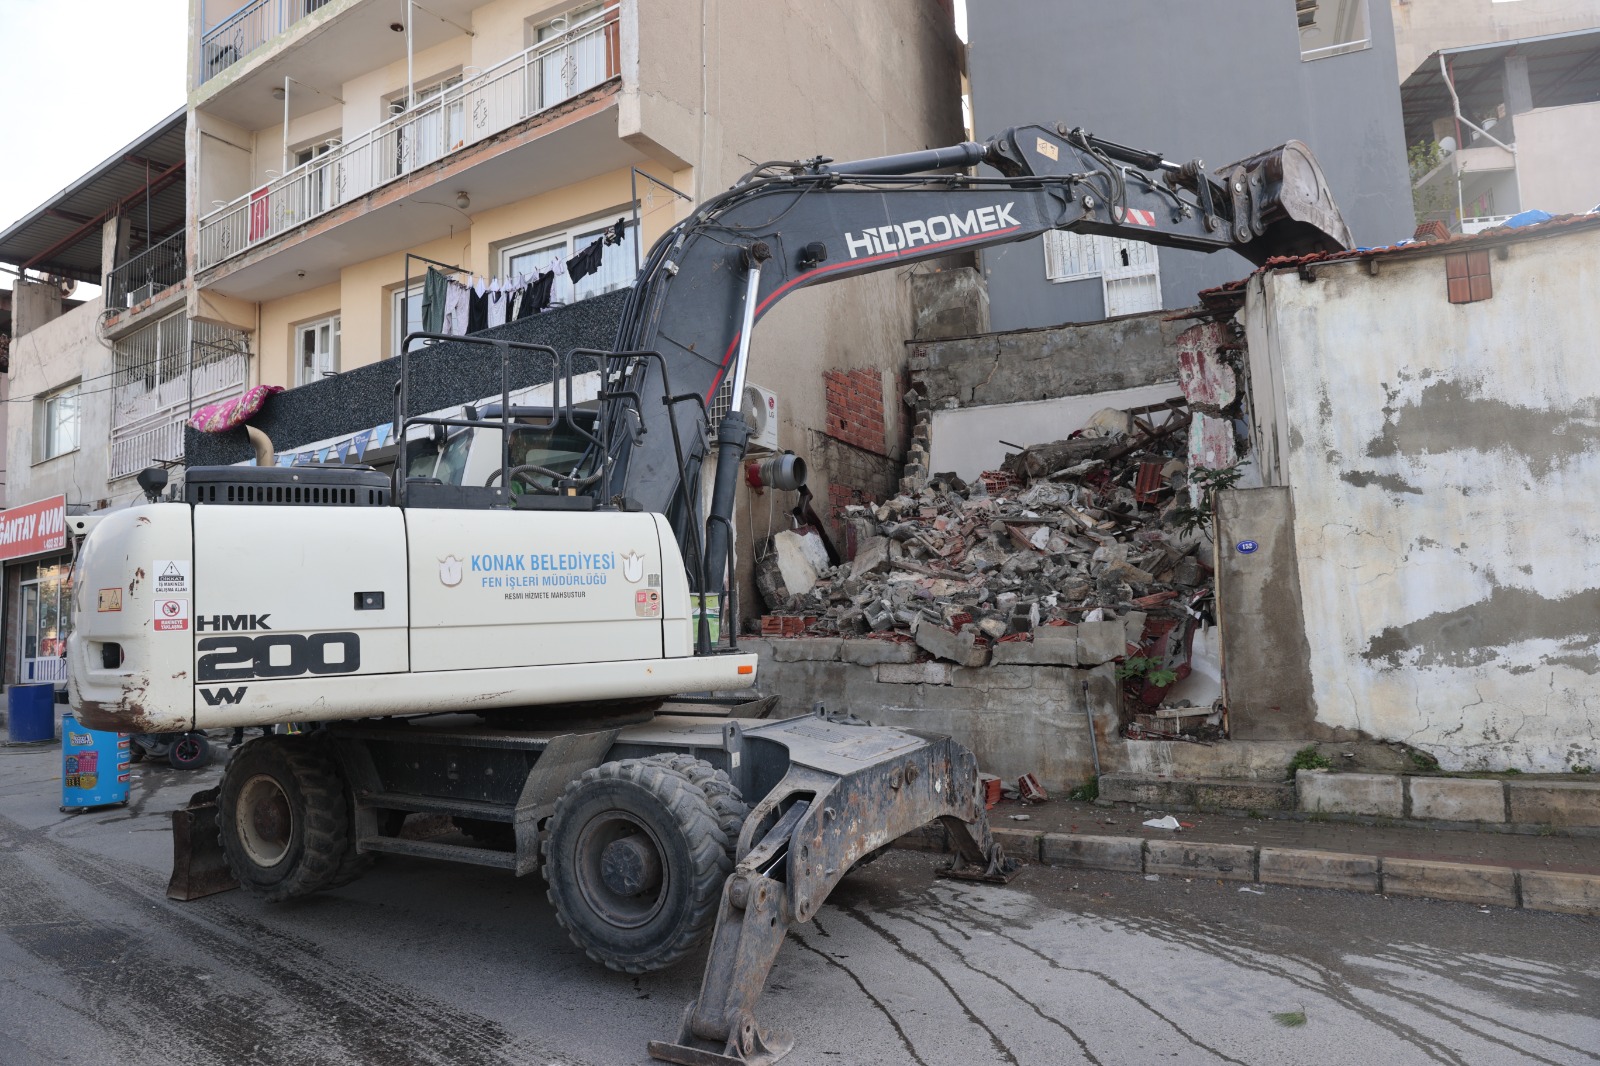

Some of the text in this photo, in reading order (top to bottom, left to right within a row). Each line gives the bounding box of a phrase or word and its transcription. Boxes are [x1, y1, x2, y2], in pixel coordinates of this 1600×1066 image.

[38, 506, 64, 537] AVM
[471, 552, 615, 571] KONAK BELEDİYESİ
[482, 573, 607, 590] FEN İŞLERİ MÜDÜRLÜĞÜ
[551, 591, 586, 599] MAHSUSTUR
[197, 614, 272, 631] HMK
[198, 632, 360, 681] 200
[199, 686, 248, 706] W
